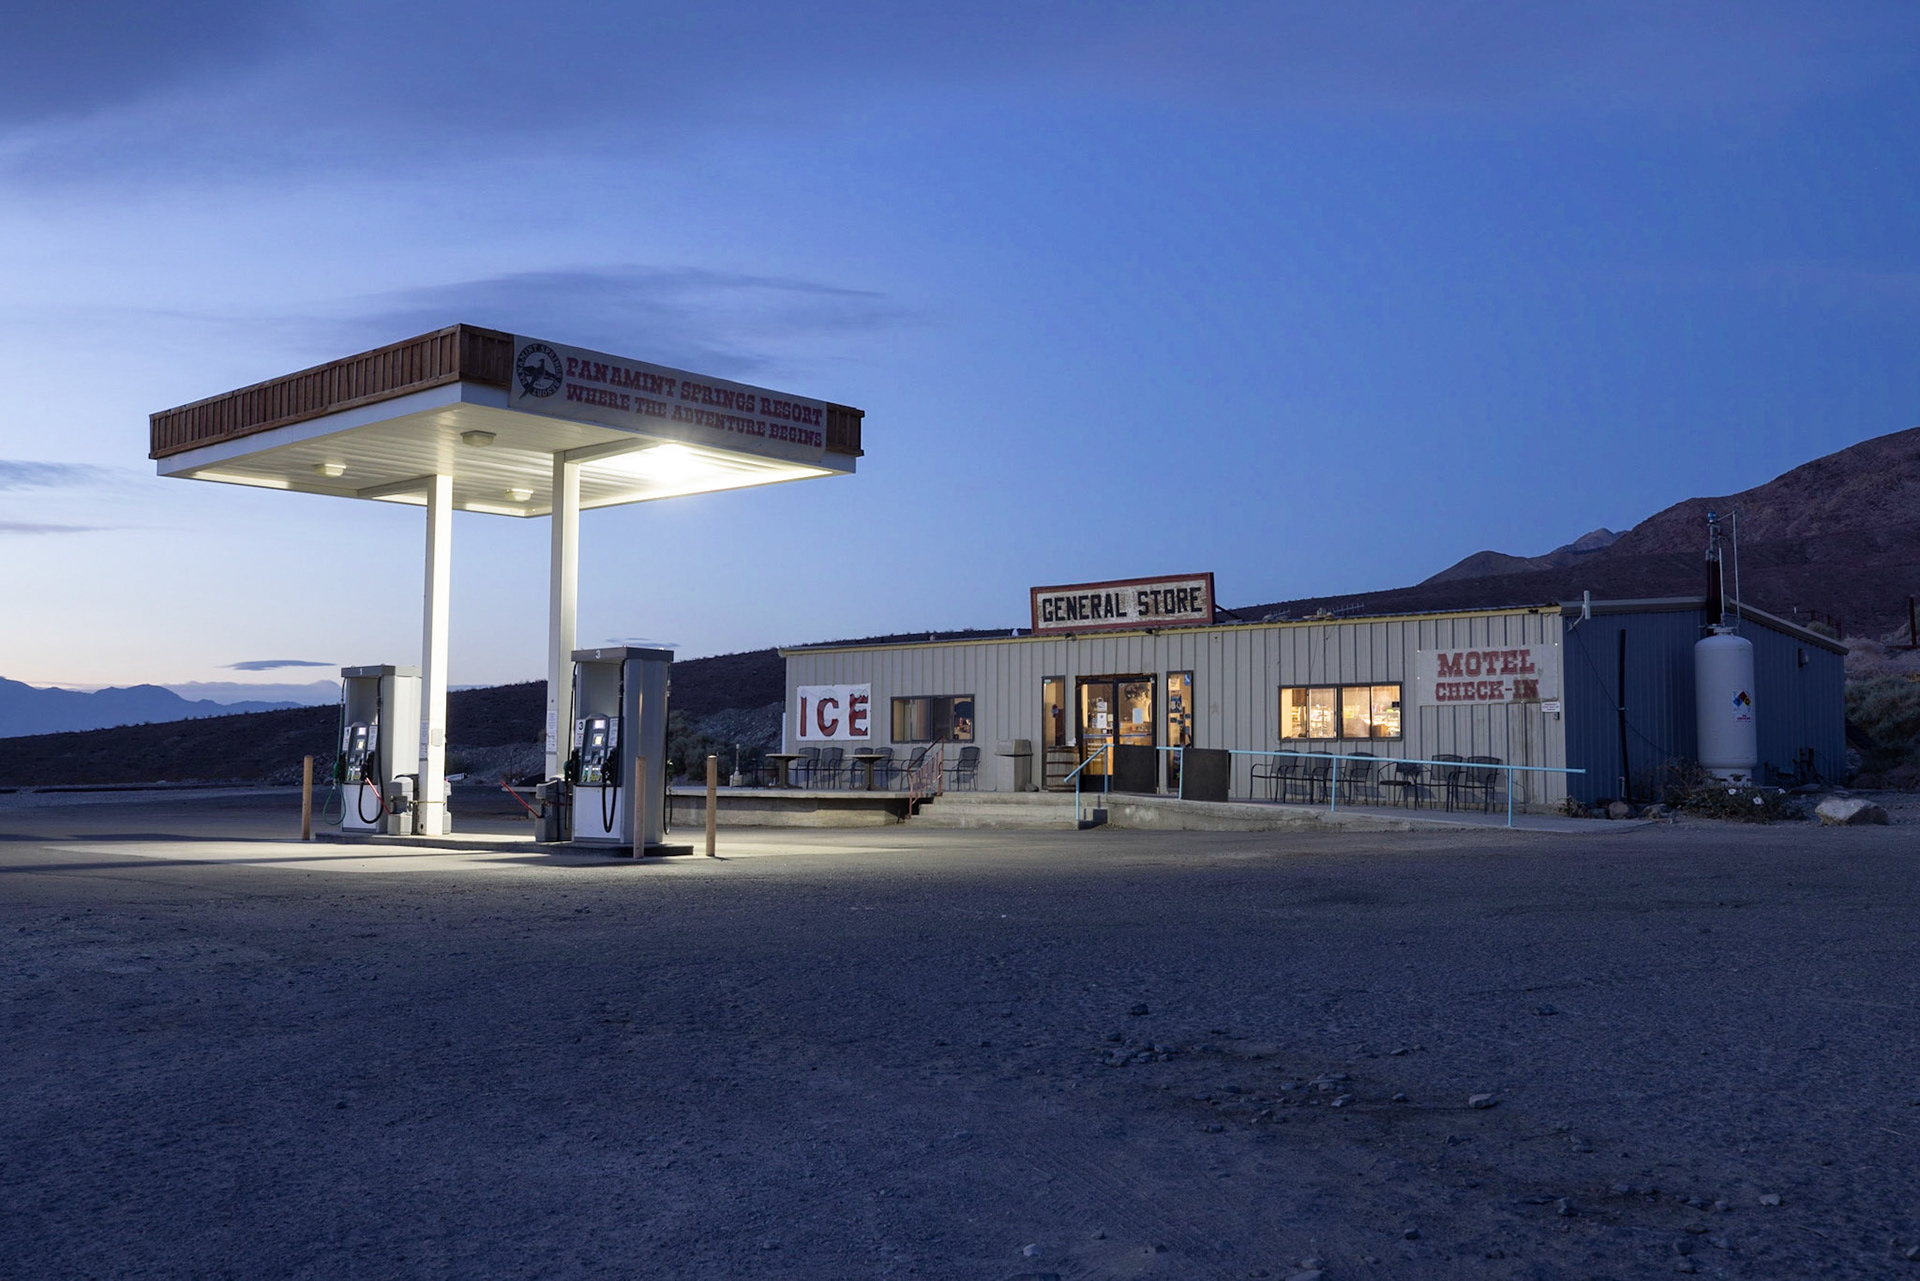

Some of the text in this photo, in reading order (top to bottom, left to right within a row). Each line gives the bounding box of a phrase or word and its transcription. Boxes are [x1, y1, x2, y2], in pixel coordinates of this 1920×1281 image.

[566, 357, 822, 426] PANAMINT SPRINGS RESORT
[566, 383, 822, 447] WHERE THE ADVENTURE BEGINS
[1042, 587, 1202, 623] GENERAL STORE
[595, 649, 601, 660] 3
[1437, 649, 1536, 678] MOTEL
[1435, 679, 1540, 702] CHECK-IN
[578, 721, 585, 731] 3
[800, 693, 869, 737] ICE
